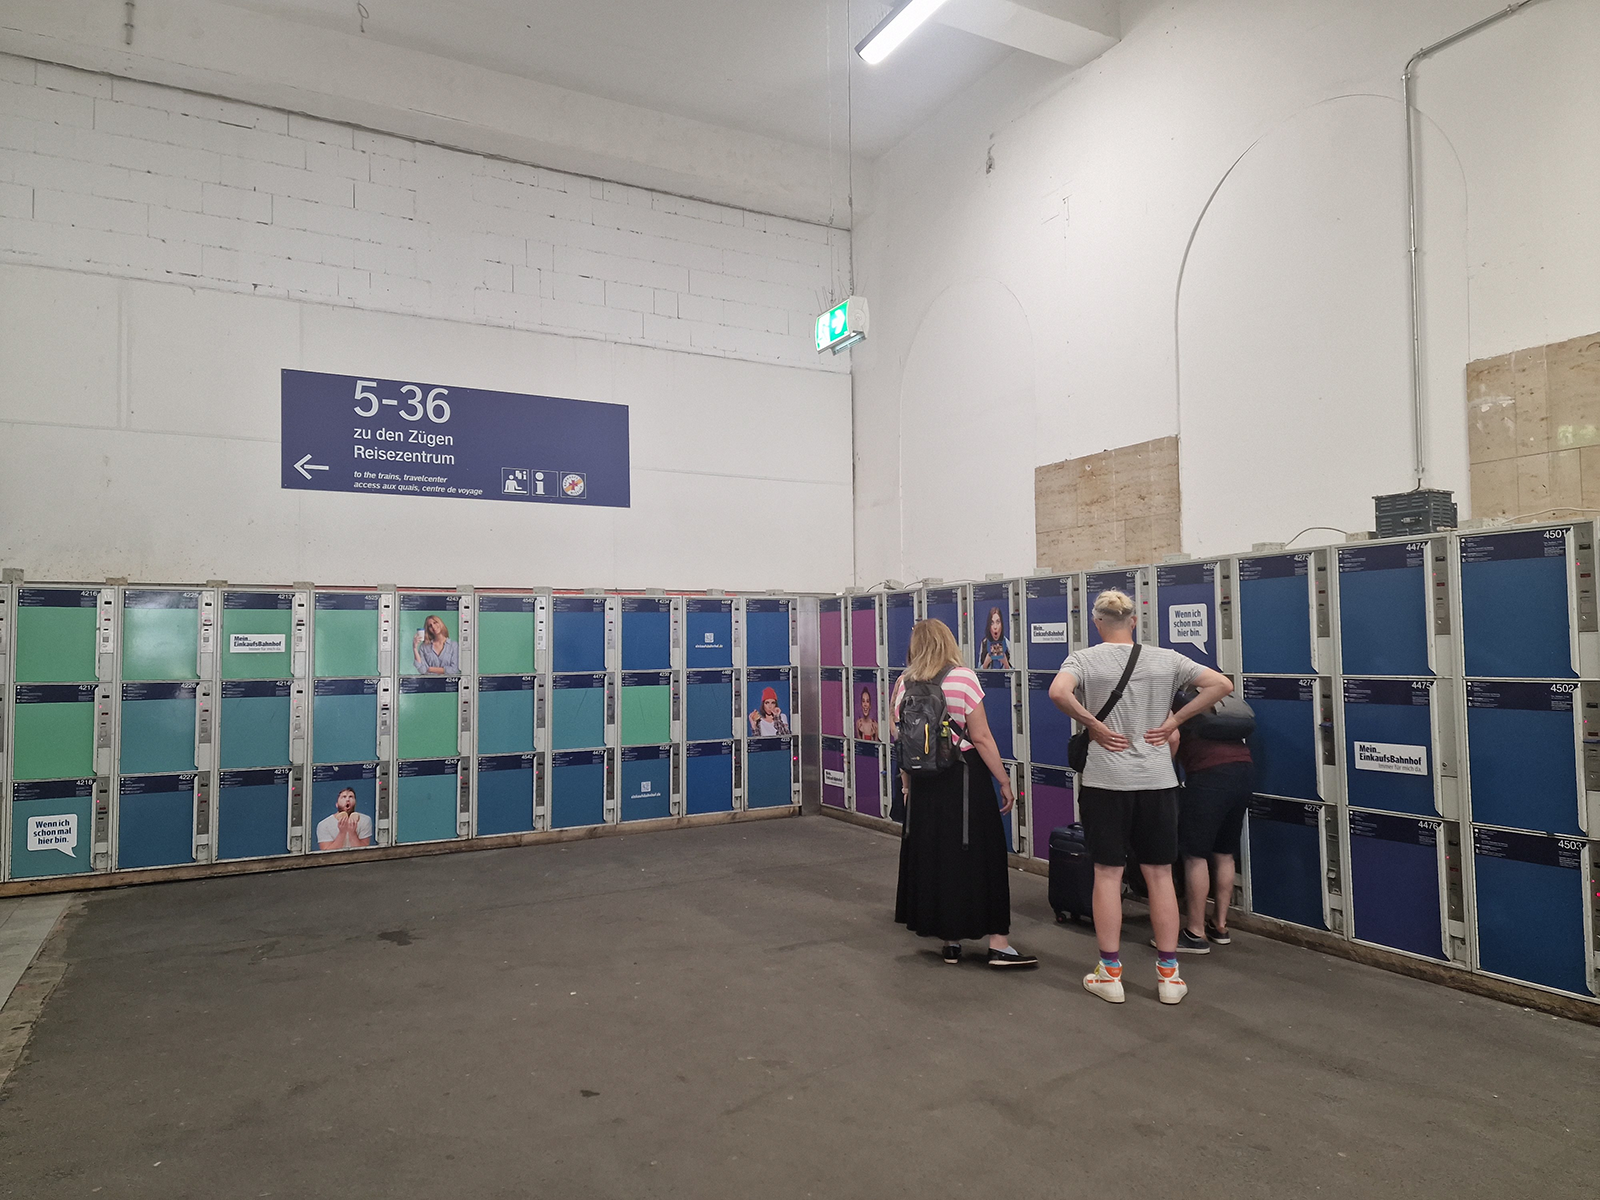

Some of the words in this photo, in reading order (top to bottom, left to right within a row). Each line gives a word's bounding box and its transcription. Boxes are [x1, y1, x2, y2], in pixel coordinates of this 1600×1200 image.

[354, 380, 451, 424] 5-36
[353, 428, 371, 439] zu
[376, 427, 404, 441] den
[408, 429, 453, 447] Zügen
[354, 445, 455, 465] Reisezentrum
[363, 471, 376, 479] the
[378, 472, 401, 481] trains,
[403, 474, 448, 483] travelcenter
[354, 481, 380, 489] access
[398, 484, 420, 492] quais,
[458, 488, 483, 496] voyage
[1543, 529, 1566, 539] 4501
[1406, 542, 1425, 551] 4474
[1174, 610, 1191, 618] Wenn
[1192, 609, 1201, 617] ich
[1173, 619, 1191, 628] schon
[1192, 618, 1203, 627] mal
[1177, 629, 1188, 637] hier
[1190, 628, 1201, 636] bin.
[1298, 680, 1313, 688] 4274
[1411, 681, 1431, 690] 4475
[1550, 683, 1574, 693] 4502
[1359, 753, 1422, 766] EinkaufsBahnhof
[1304, 804, 1320, 813] 4275
[35, 820, 57, 829] Wenn
[58, 819, 70, 827] ich
[1418, 821, 1439, 831] 4476
[33, 828, 57, 837] schon
[57, 827, 72, 835] mal
[38, 837, 54, 845] hier
[55, 836, 69, 844] bin.
[1557, 839, 1582, 850] 4503
